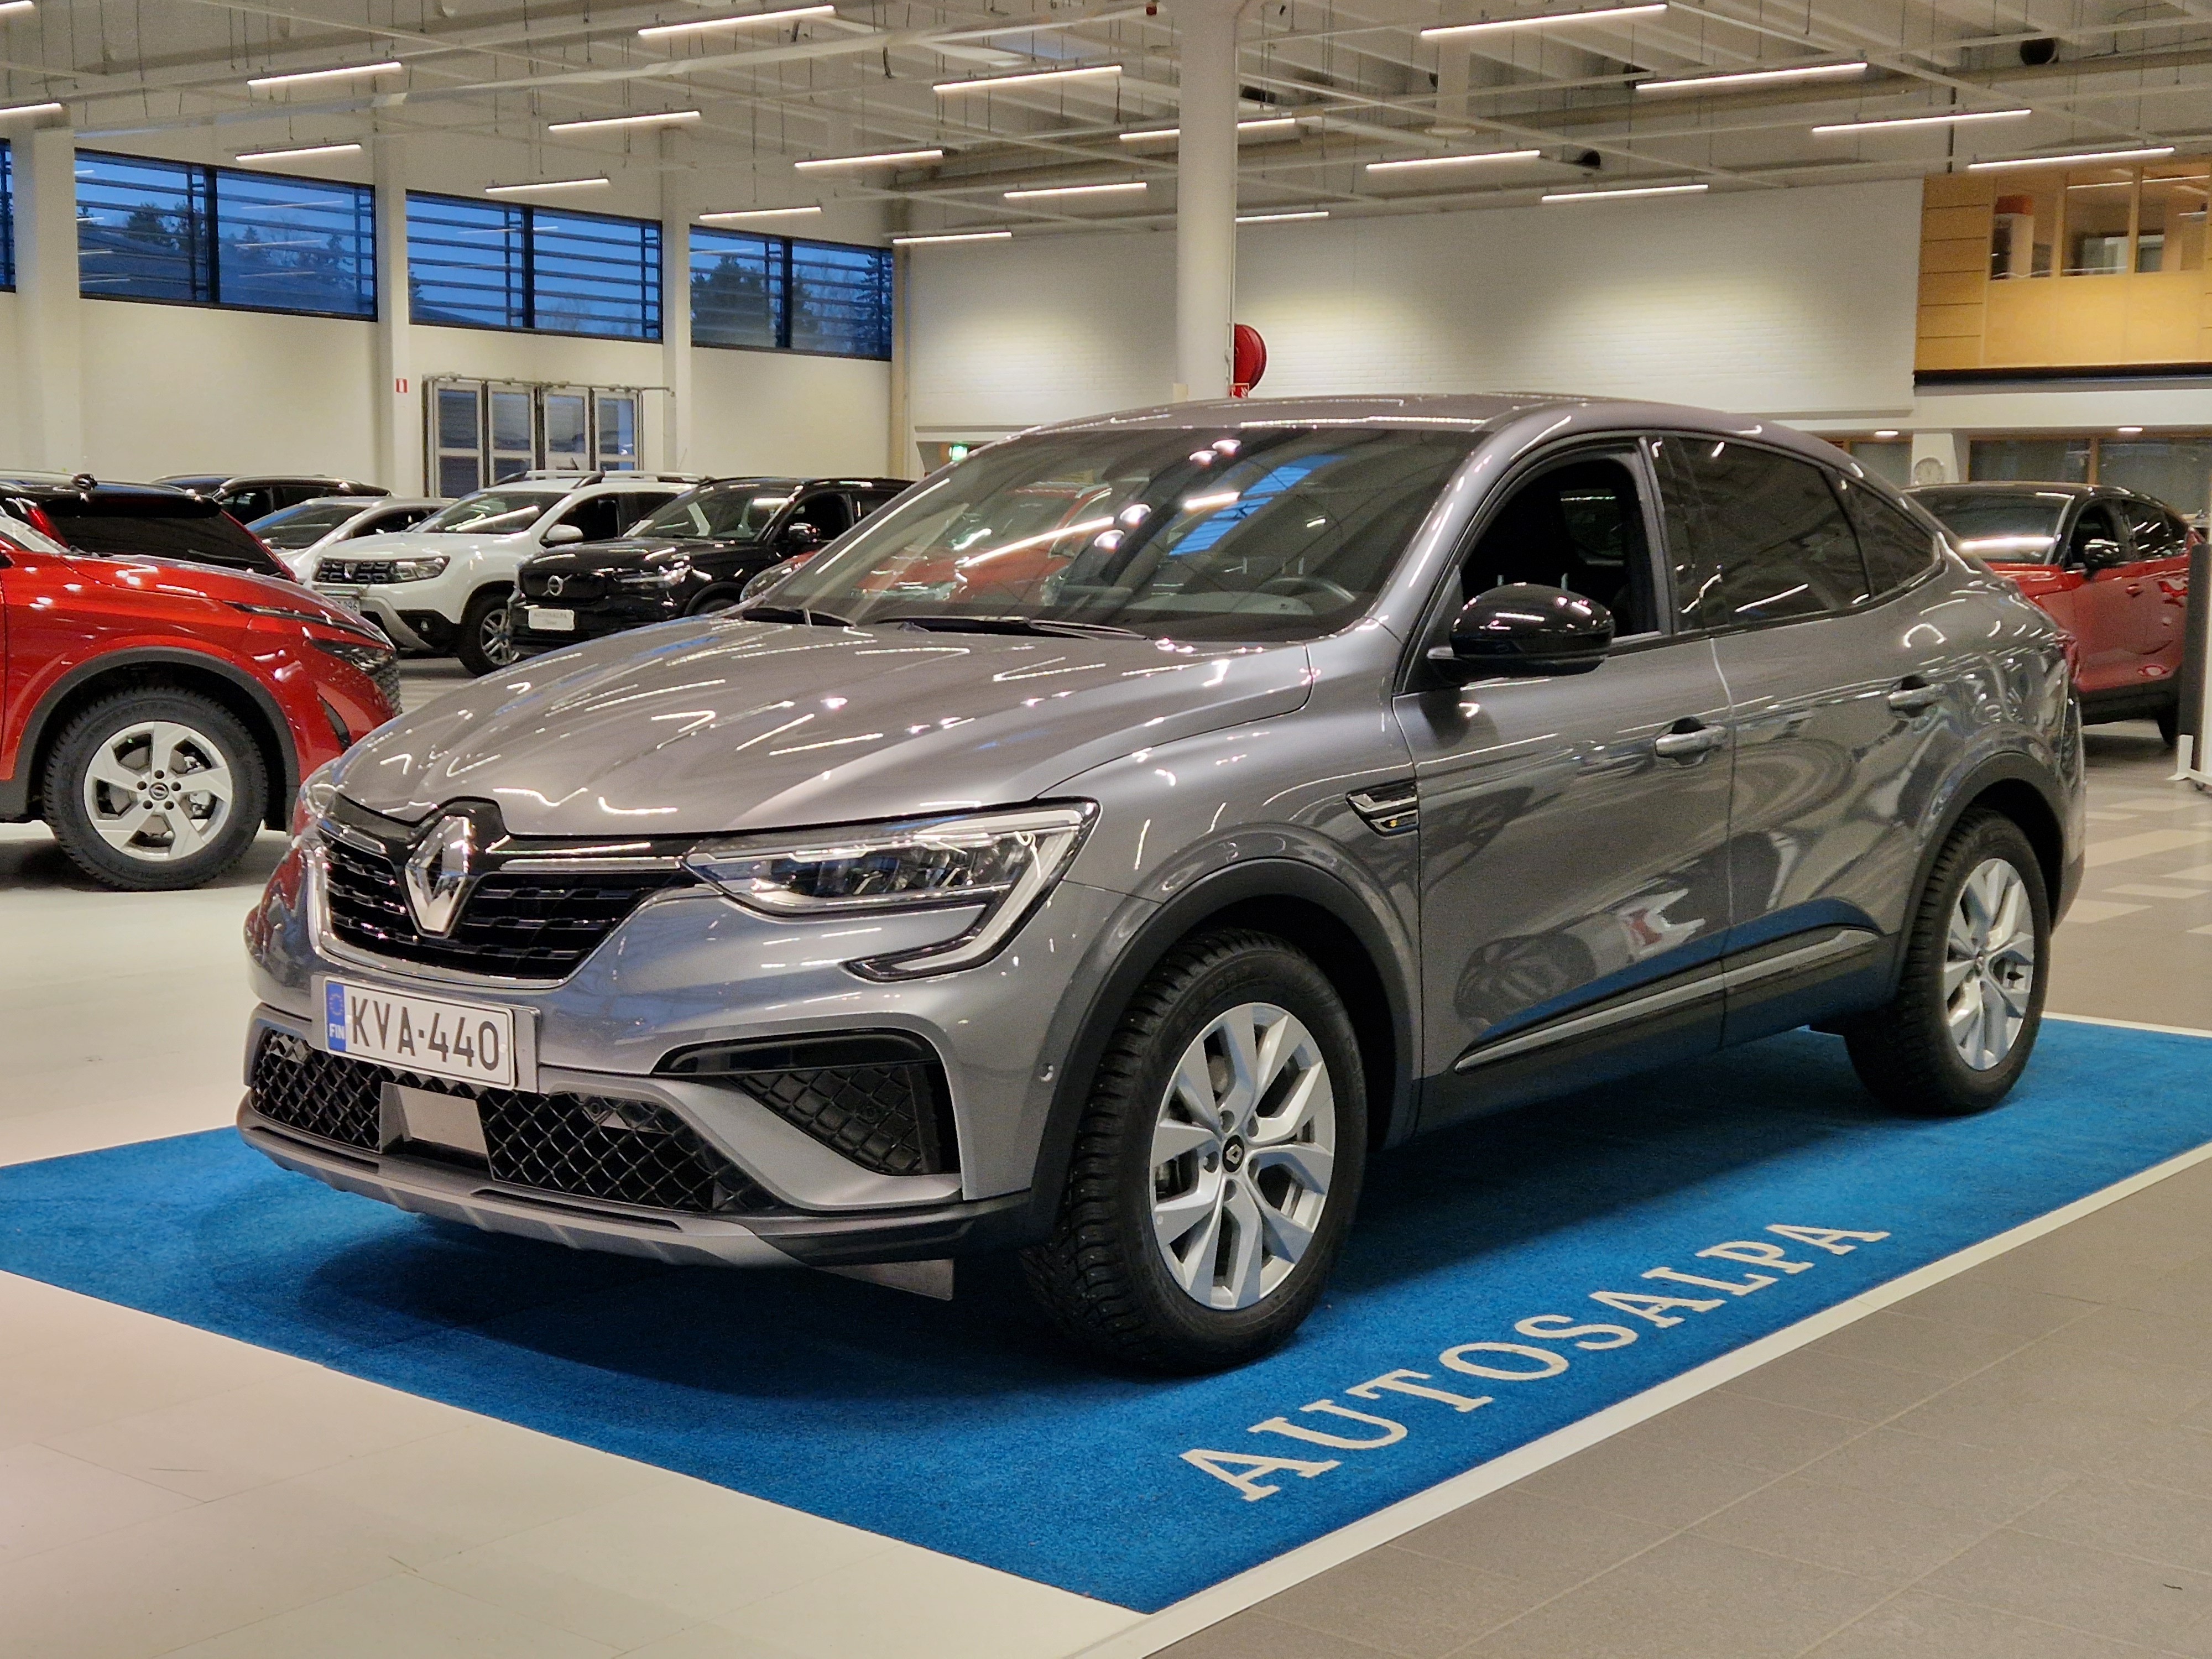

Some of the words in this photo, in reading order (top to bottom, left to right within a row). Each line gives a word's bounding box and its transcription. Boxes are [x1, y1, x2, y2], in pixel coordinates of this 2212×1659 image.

[329, 1023, 345, 1040] FIN
[351, 996, 499, 1071] KVA-440
[1180, 1224, 1890, 1502] AUTOSALPA
